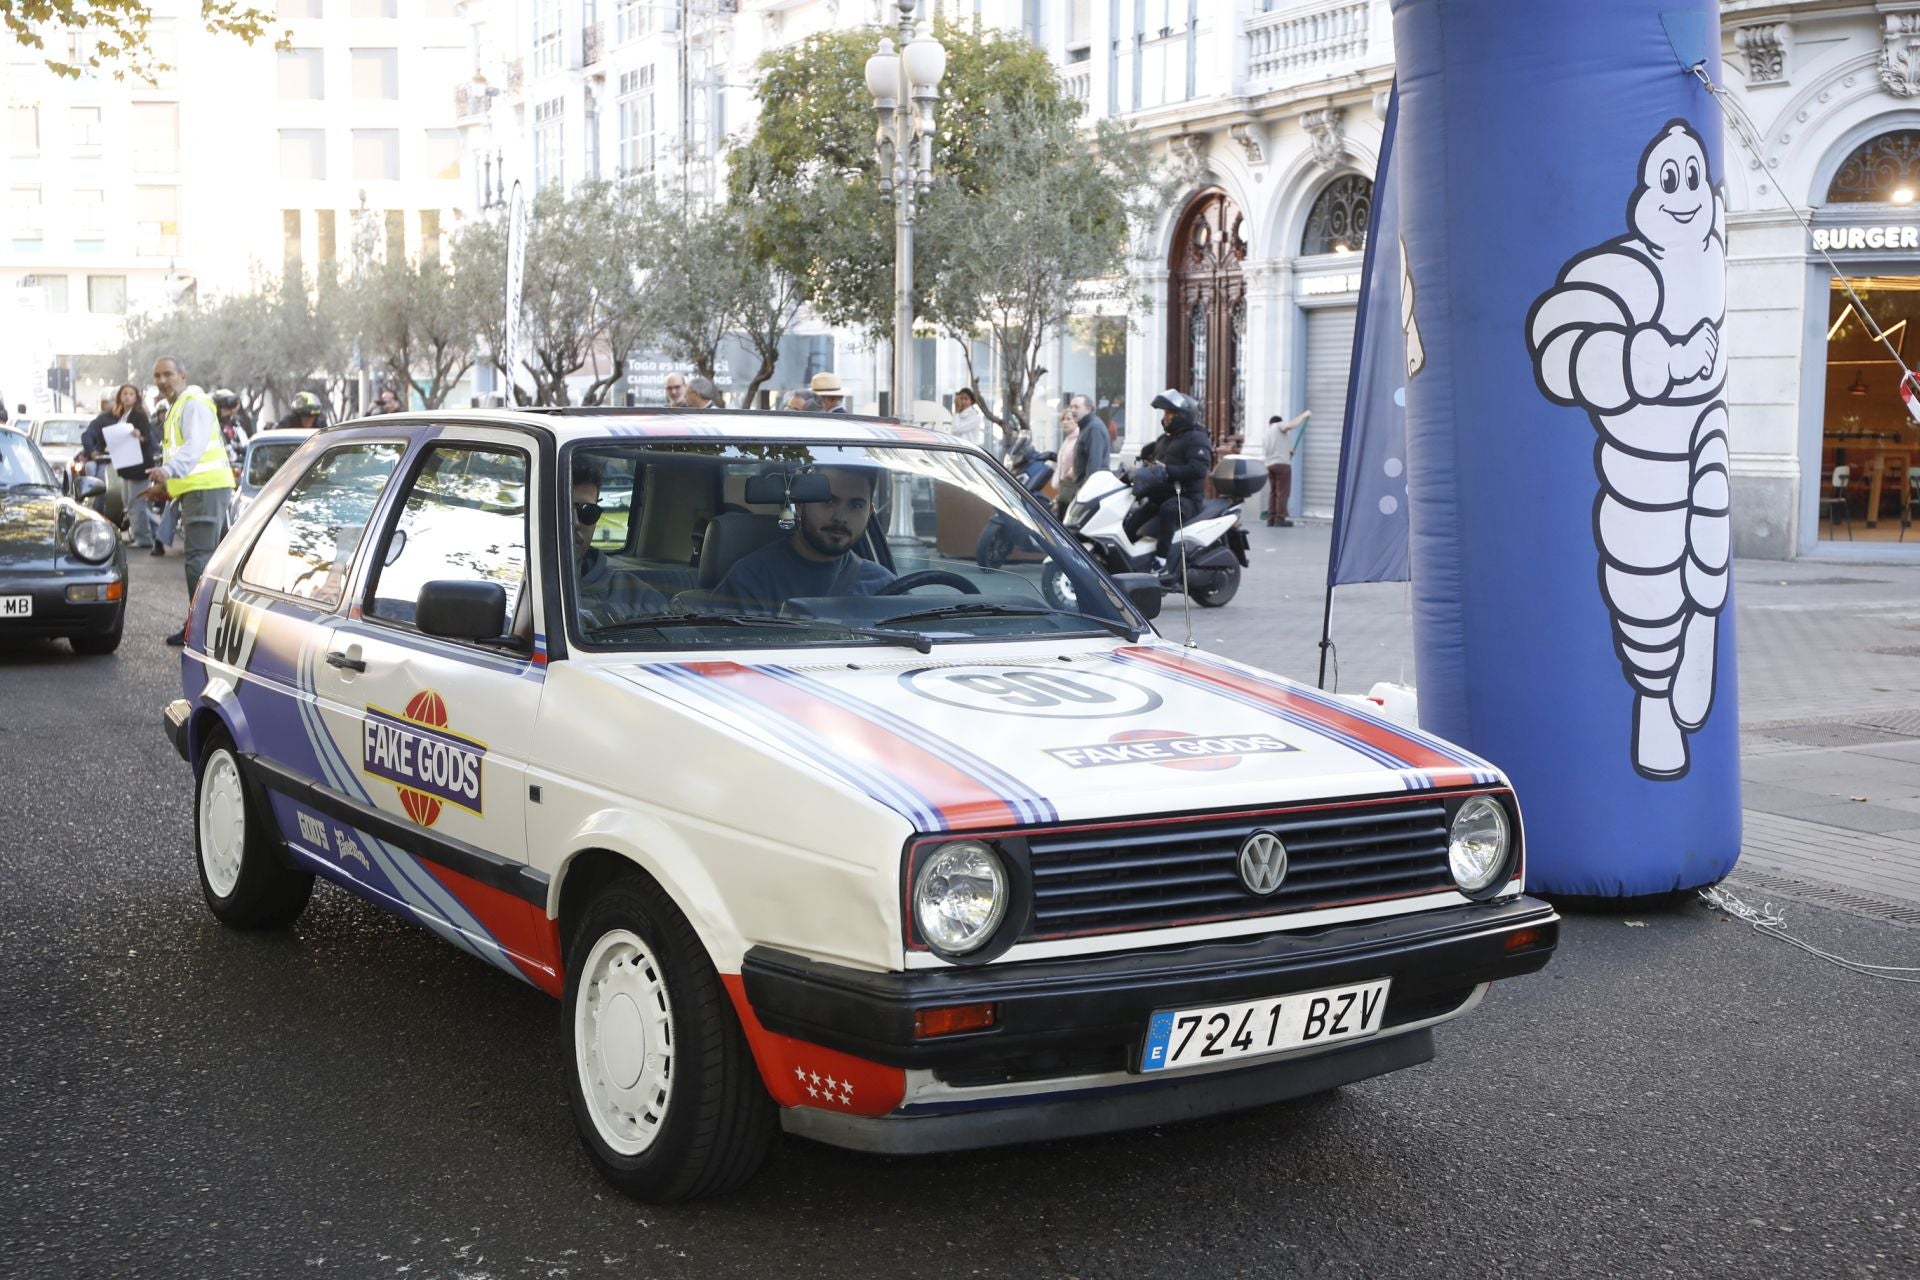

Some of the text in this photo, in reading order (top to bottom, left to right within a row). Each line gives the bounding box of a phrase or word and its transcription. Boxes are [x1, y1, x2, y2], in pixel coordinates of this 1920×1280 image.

[1813, 226, 1918, 250] BURGER
[627, 373, 666, 384] cuand
[628, 359, 656, 371] Todo
[659, 362, 672, 371] es
[6, 599, 29, 614] MB
[945, 671, 1117, 707] 90
[365, 720, 479, 799] FAKE GODS
[1055, 736, 1290, 767] FAKE GODS
[1151, 987, 1383, 1062] E 7241 BZV
